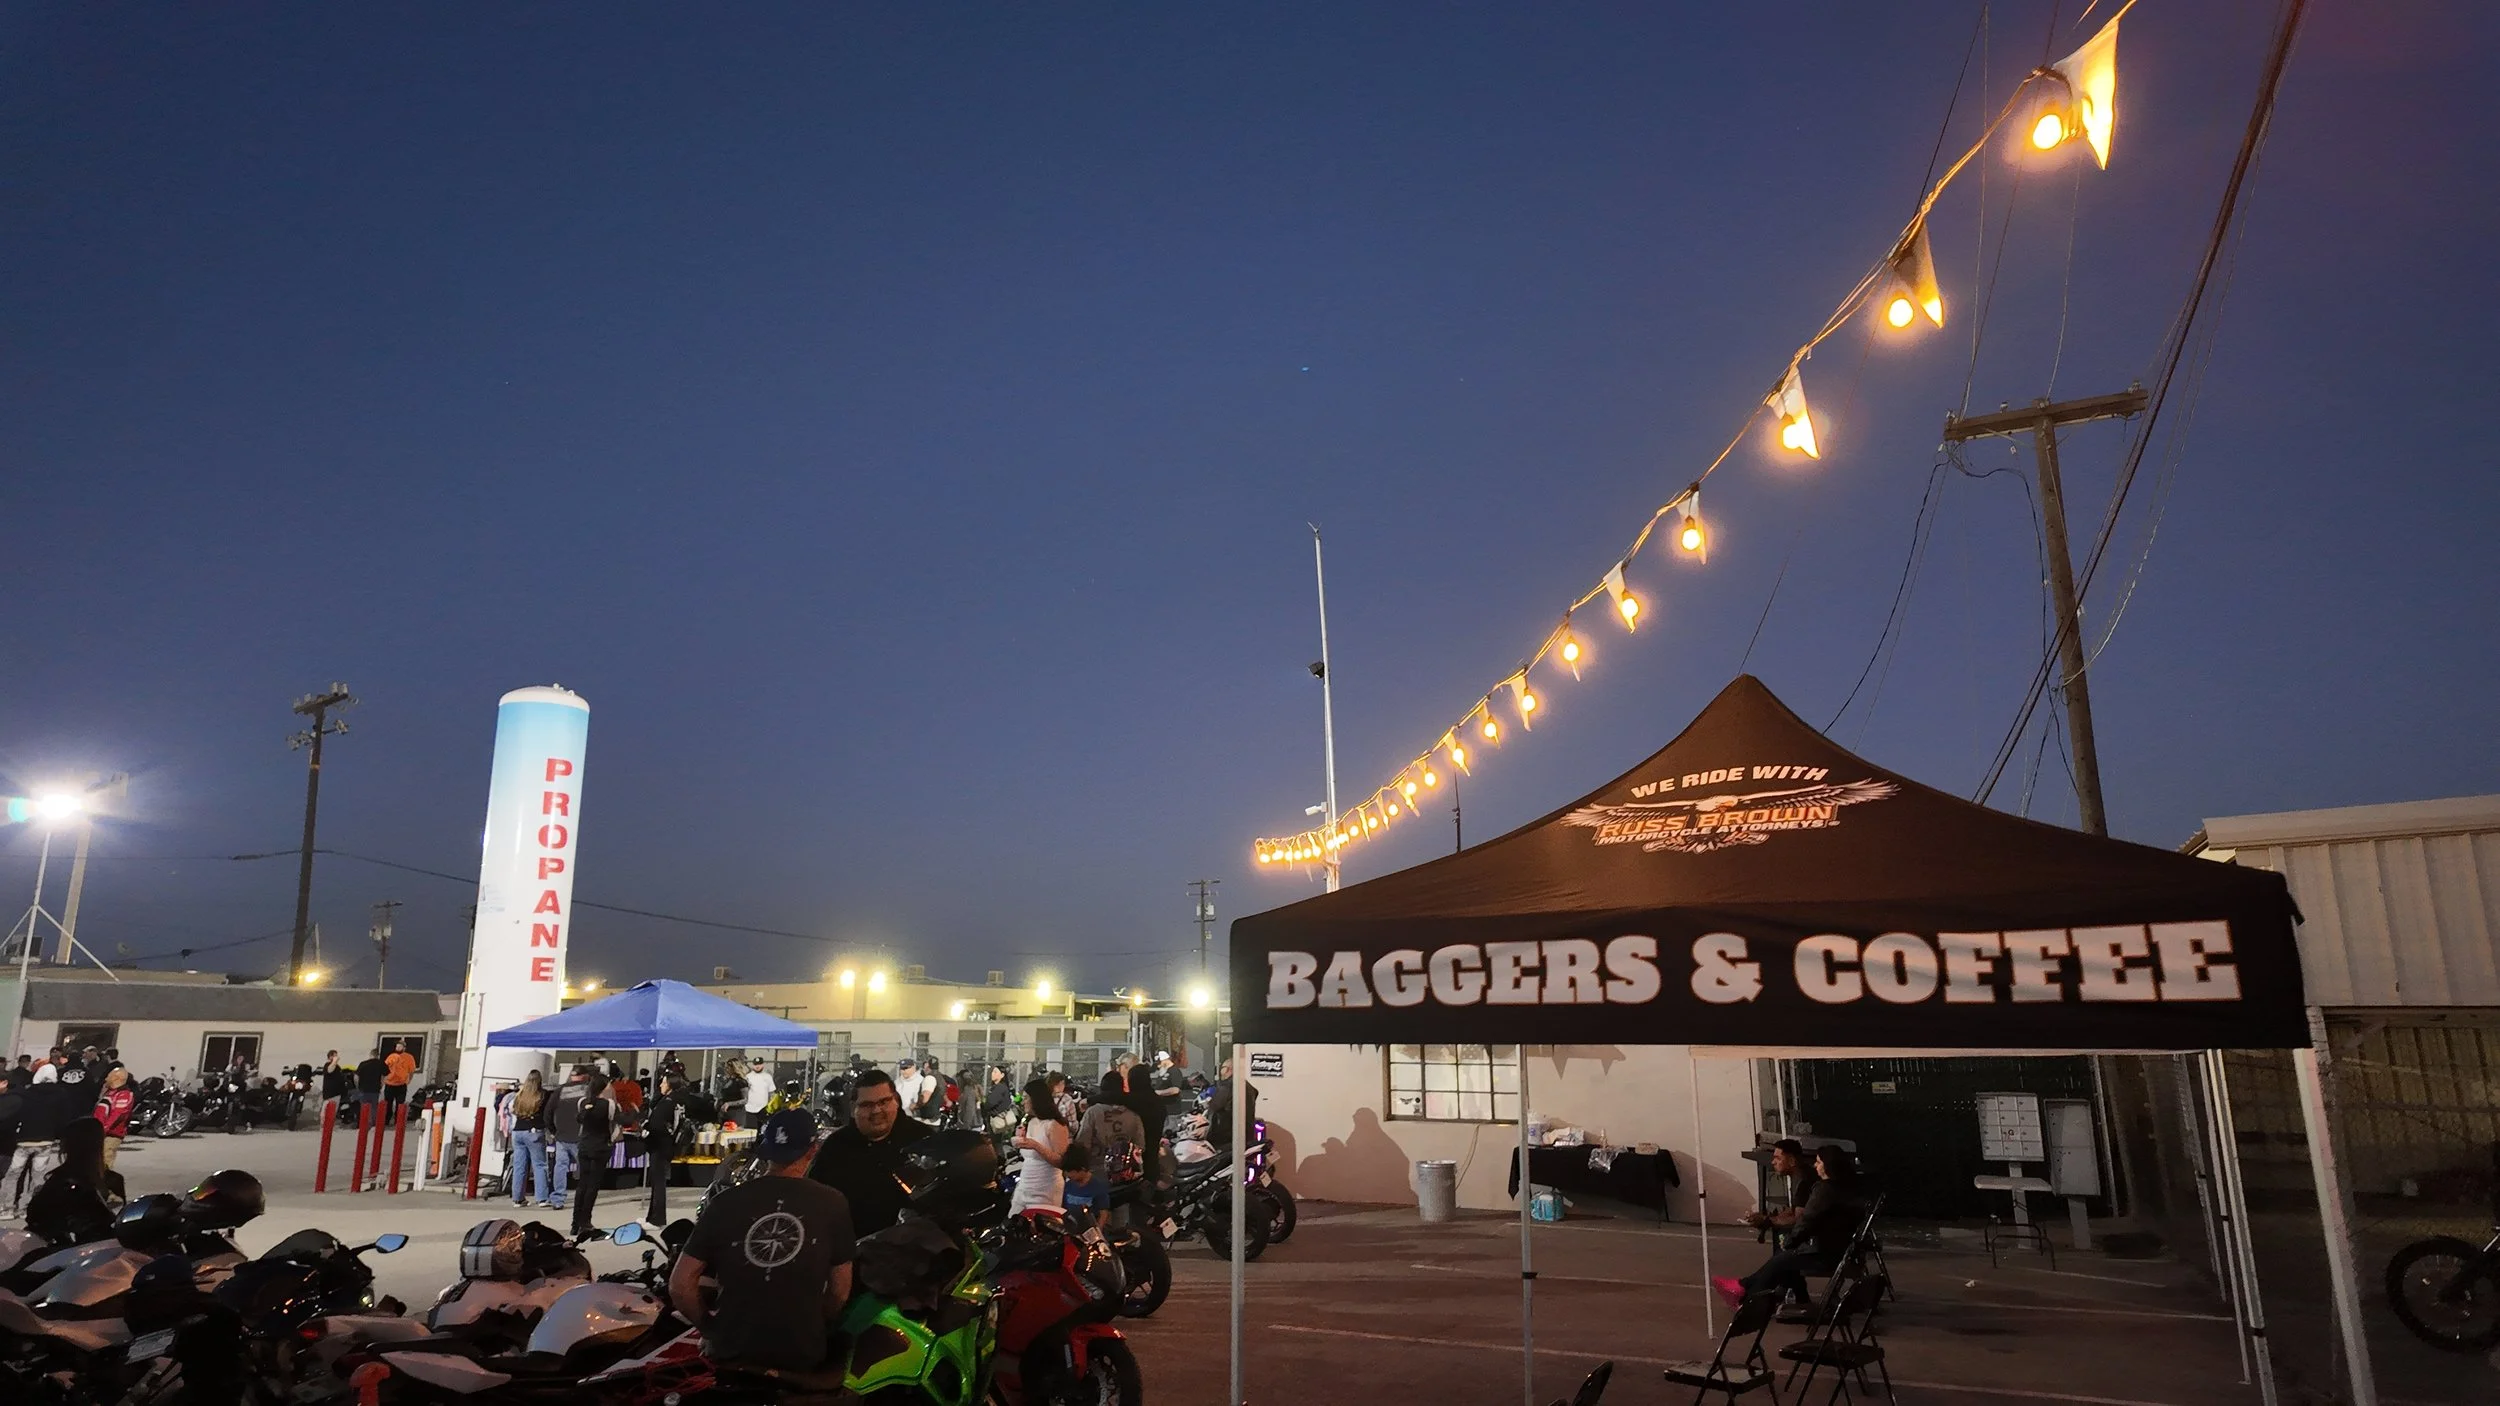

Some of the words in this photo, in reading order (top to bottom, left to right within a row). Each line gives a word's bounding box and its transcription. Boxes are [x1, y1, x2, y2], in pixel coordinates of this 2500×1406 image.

[1630, 780, 1676, 799] WE
[1681, 766, 1746, 789] RIDE
[1752, 765, 1830, 781] WITH
[1597, 826, 1712, 845] MOTORCYCLE
[1715, 820, 1825, 834] ATTORNEYS
[1599, 815, 1688, 838] RUSS
[1696, 805, 1834, 828] BROWN
[529, 757, 574, 982] PROPANE
[1266, 935, 1662, 1009] BAGGERS
[1691, 932, 1764, 1004] &
[1793, 919, 2243, 1004] COFFEE
